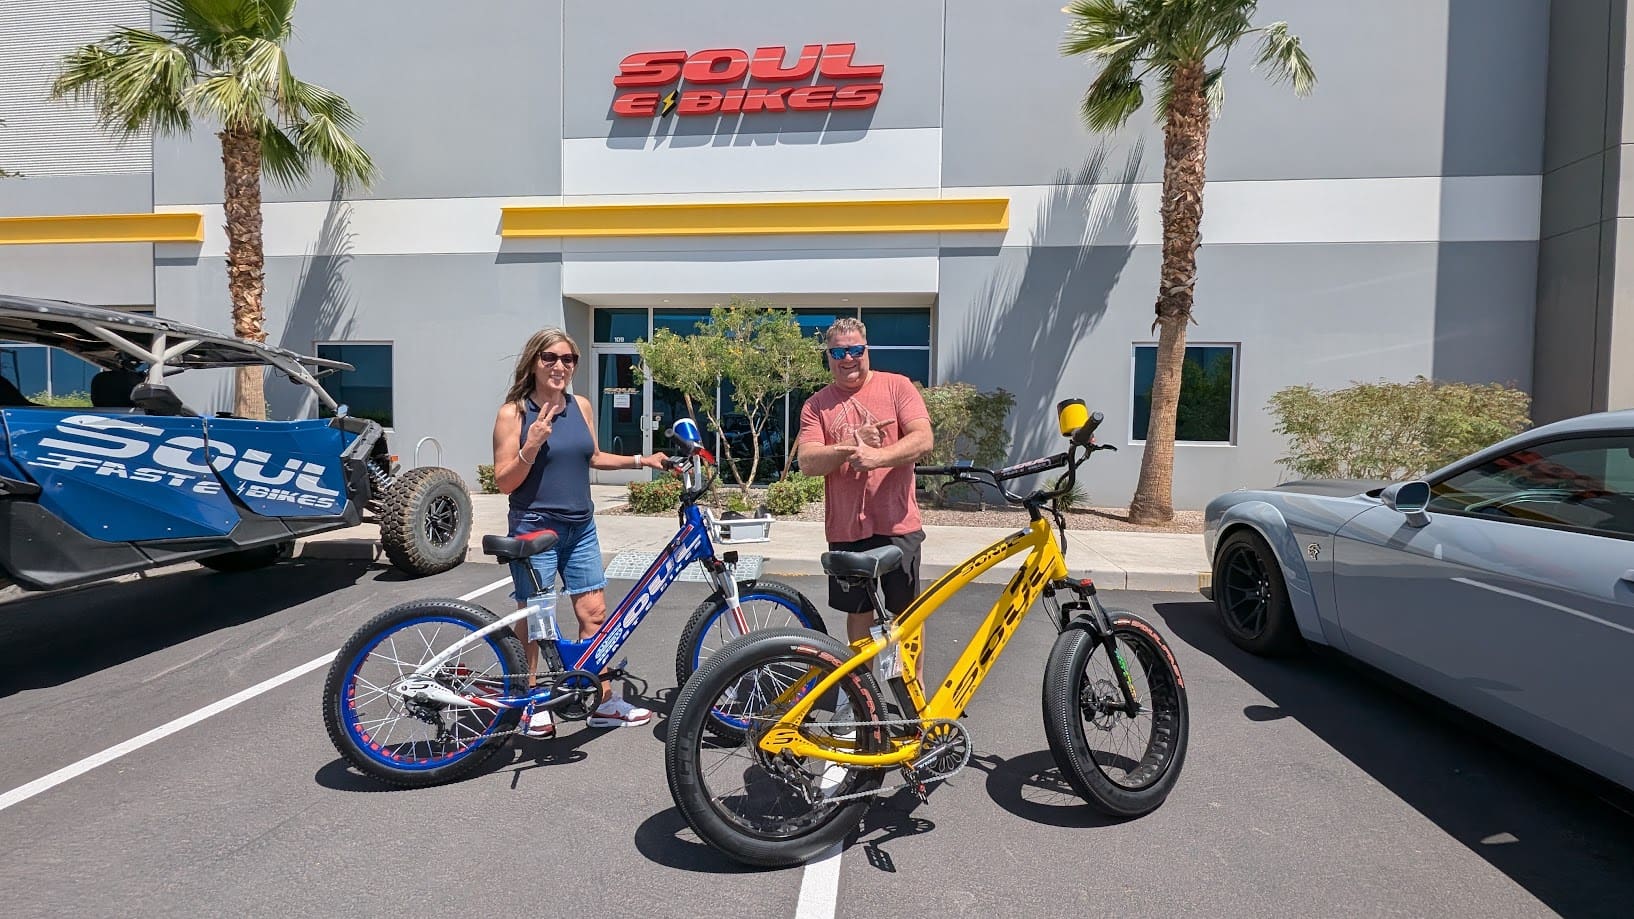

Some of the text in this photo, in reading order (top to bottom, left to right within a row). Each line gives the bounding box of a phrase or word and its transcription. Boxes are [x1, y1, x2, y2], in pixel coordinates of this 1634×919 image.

[613, 43, 884, 87] SOUL
[612, 83, 883, 117] E BIKES
[38, 414, 340, 497] SOUL
[246, 484, 336, 509] BIKES
[595, 534, 702, 665] SOUL
[952, 555, 1056, 709] SOUL
